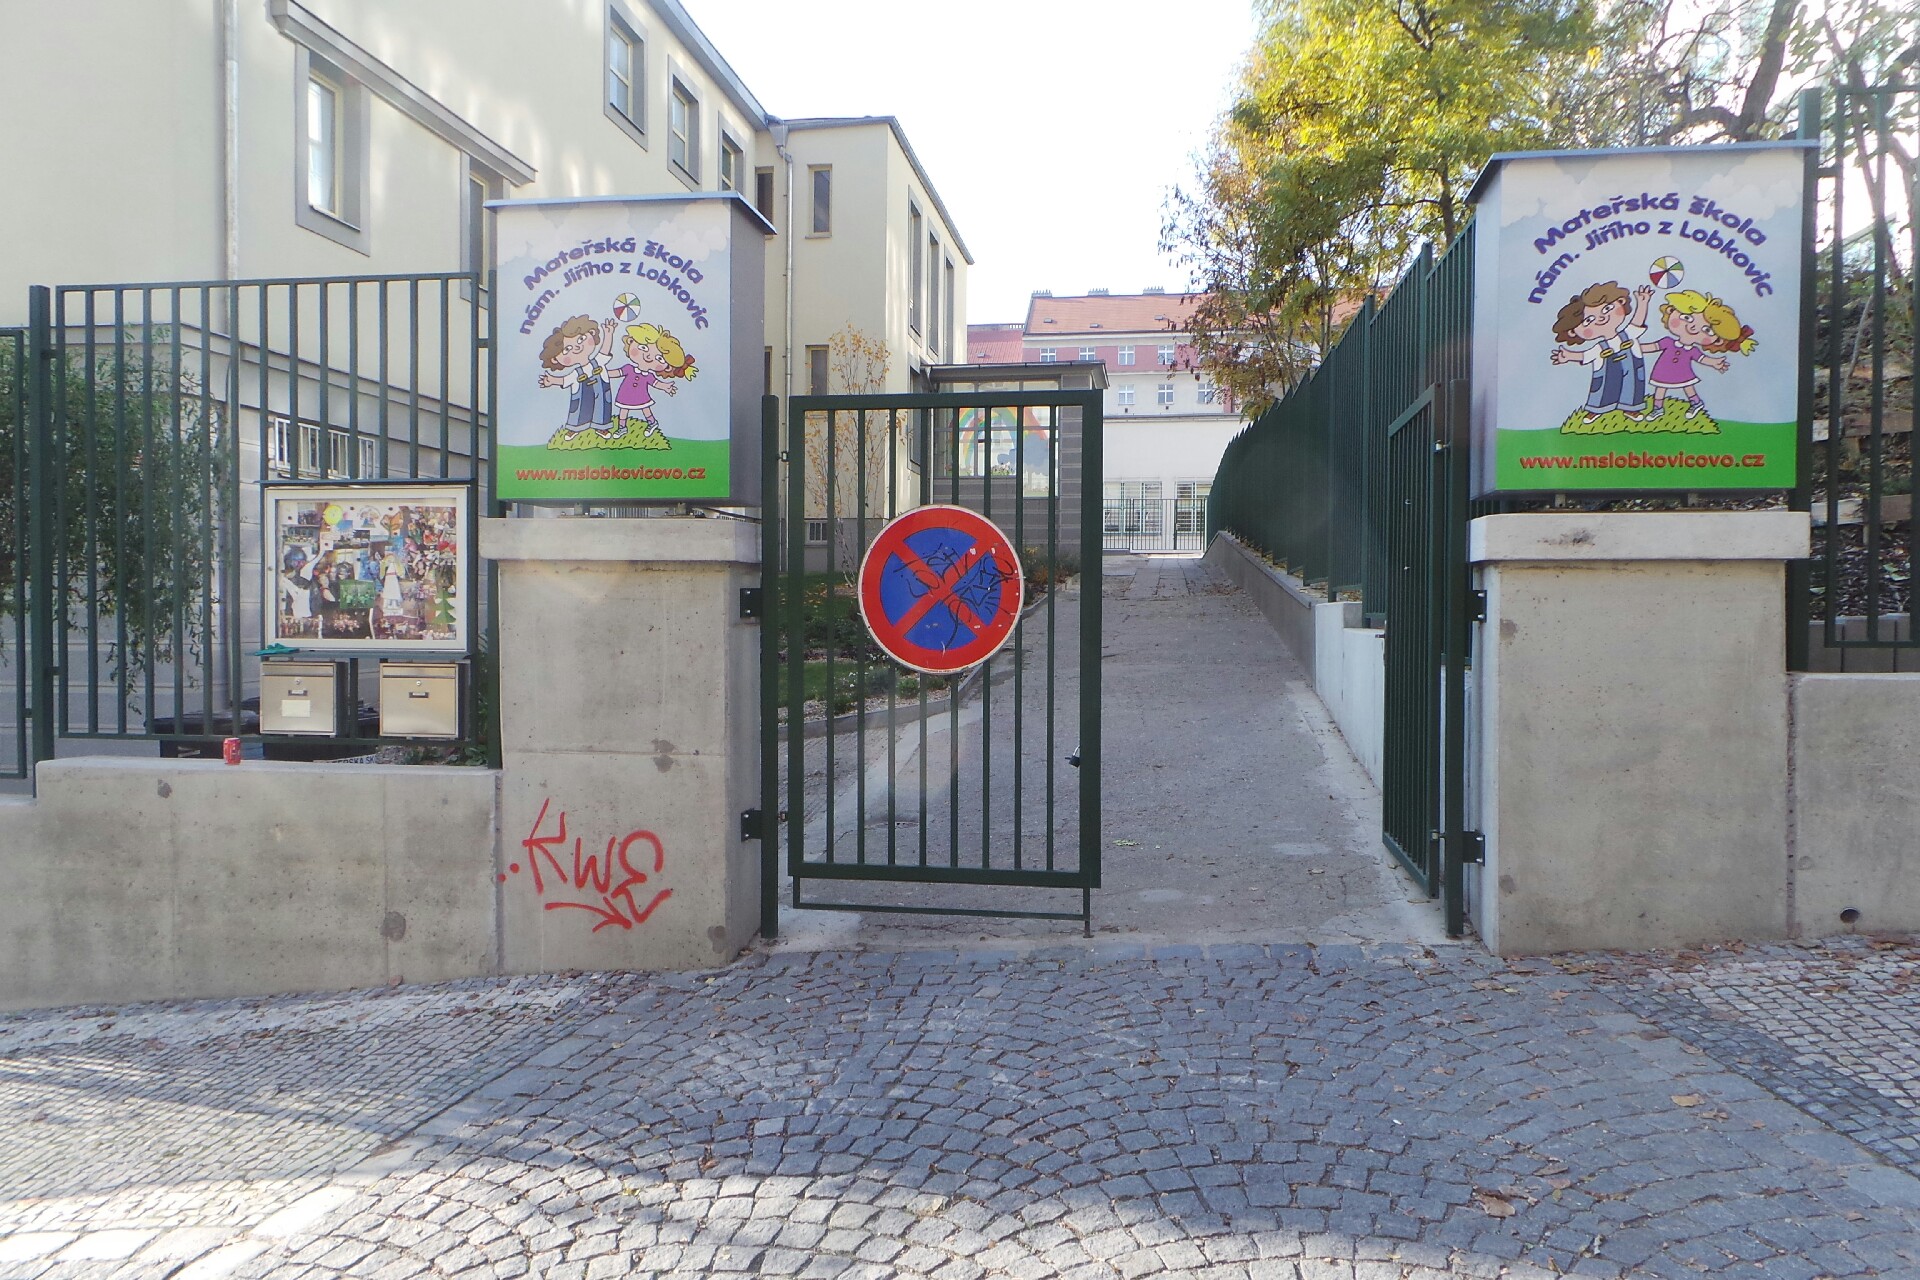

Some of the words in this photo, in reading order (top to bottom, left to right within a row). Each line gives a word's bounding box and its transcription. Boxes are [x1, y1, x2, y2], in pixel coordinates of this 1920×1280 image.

[1533, 192, 1680, 254] Mateřská
[1687, 195, 1767, 247] škola
[523, 237, 637, 290] Mateřská
[643, 239, 704, 285] škola
[1527, 252, 1580, 304] nám.
[1585, 219, 1651, 251] Jiřího
[1658, 221, 1673, 235] z
[1679, 220, 1774, 298] Lobkovic
[519, 289, 560, 335] nám.
[564, 261, 614, 287] Jiřího
[619, 262, 631, 274] z
[636, 261, 709, 331] Lobkovic
[516, 465, 706, 481] www.mslobkovicovo.cz
[1519, 451, 1766, 469] www.mslobkovicovo.cz
